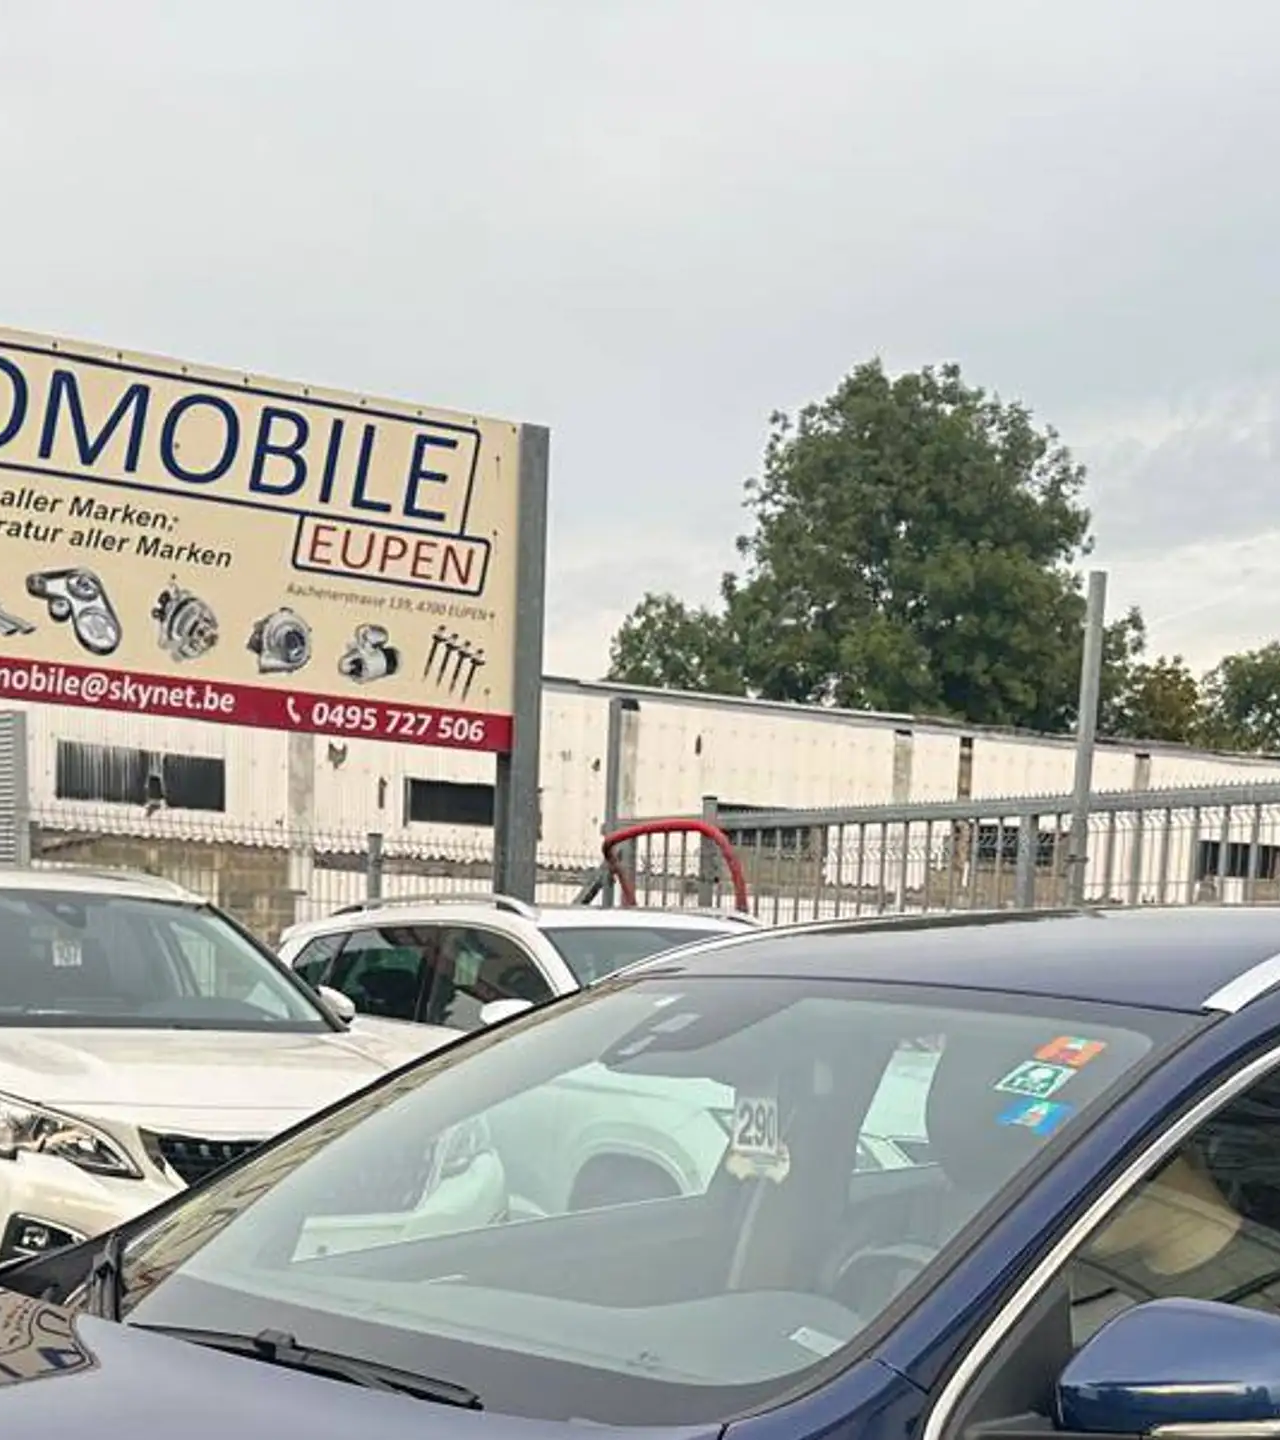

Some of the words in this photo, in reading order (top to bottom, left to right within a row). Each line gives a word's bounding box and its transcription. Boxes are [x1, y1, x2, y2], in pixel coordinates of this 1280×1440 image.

[0, 487, 62, 514] aller
[69, 528, 130, 553] aller
[135, 535, 233, 569] Marken
[308, 523, 475, 586] EUPEN
[311, 702, 378, 732] 0495
[384, 710, 433, 736] 727
[437, 716, 486, 742] 506
[737, 1102, 776, 1148] 290
